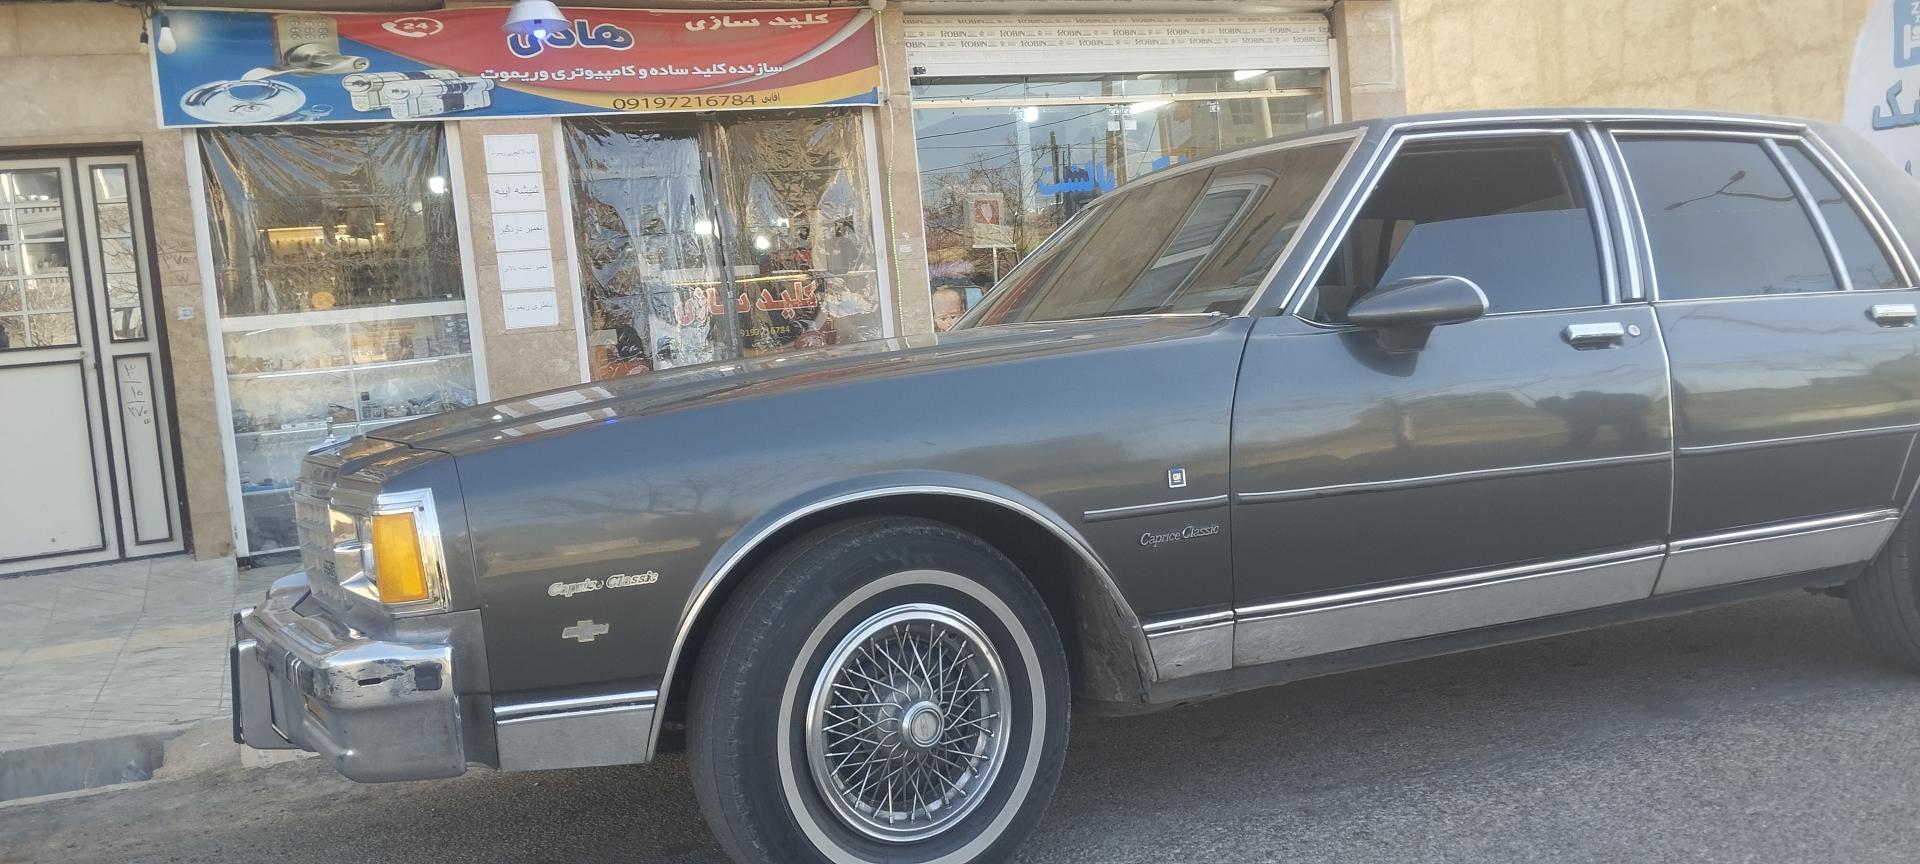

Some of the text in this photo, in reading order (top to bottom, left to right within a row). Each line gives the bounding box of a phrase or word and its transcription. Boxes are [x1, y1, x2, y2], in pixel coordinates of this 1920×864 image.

[403, 22, 428, 30] 24
[685, 13, 829, 31] کلید سازی
[507, 19, 635, 58] هادی
[551, 65, 636, 81] کامپیوتری
[638, 69, 647, 79] و
[650, 64, 688, 76] ساده
[691, 63, 727, 77] کلید
[729, 63, 783, 76] سازنده
[613, 94, 757, 110] 09197216784
[514, 185, 540, 196] شیشه
[756, 281, 818, 319] کلید
[1140, 525, 1220, 548] Caprice Classic
[606, 570, 659, 589] Classic
